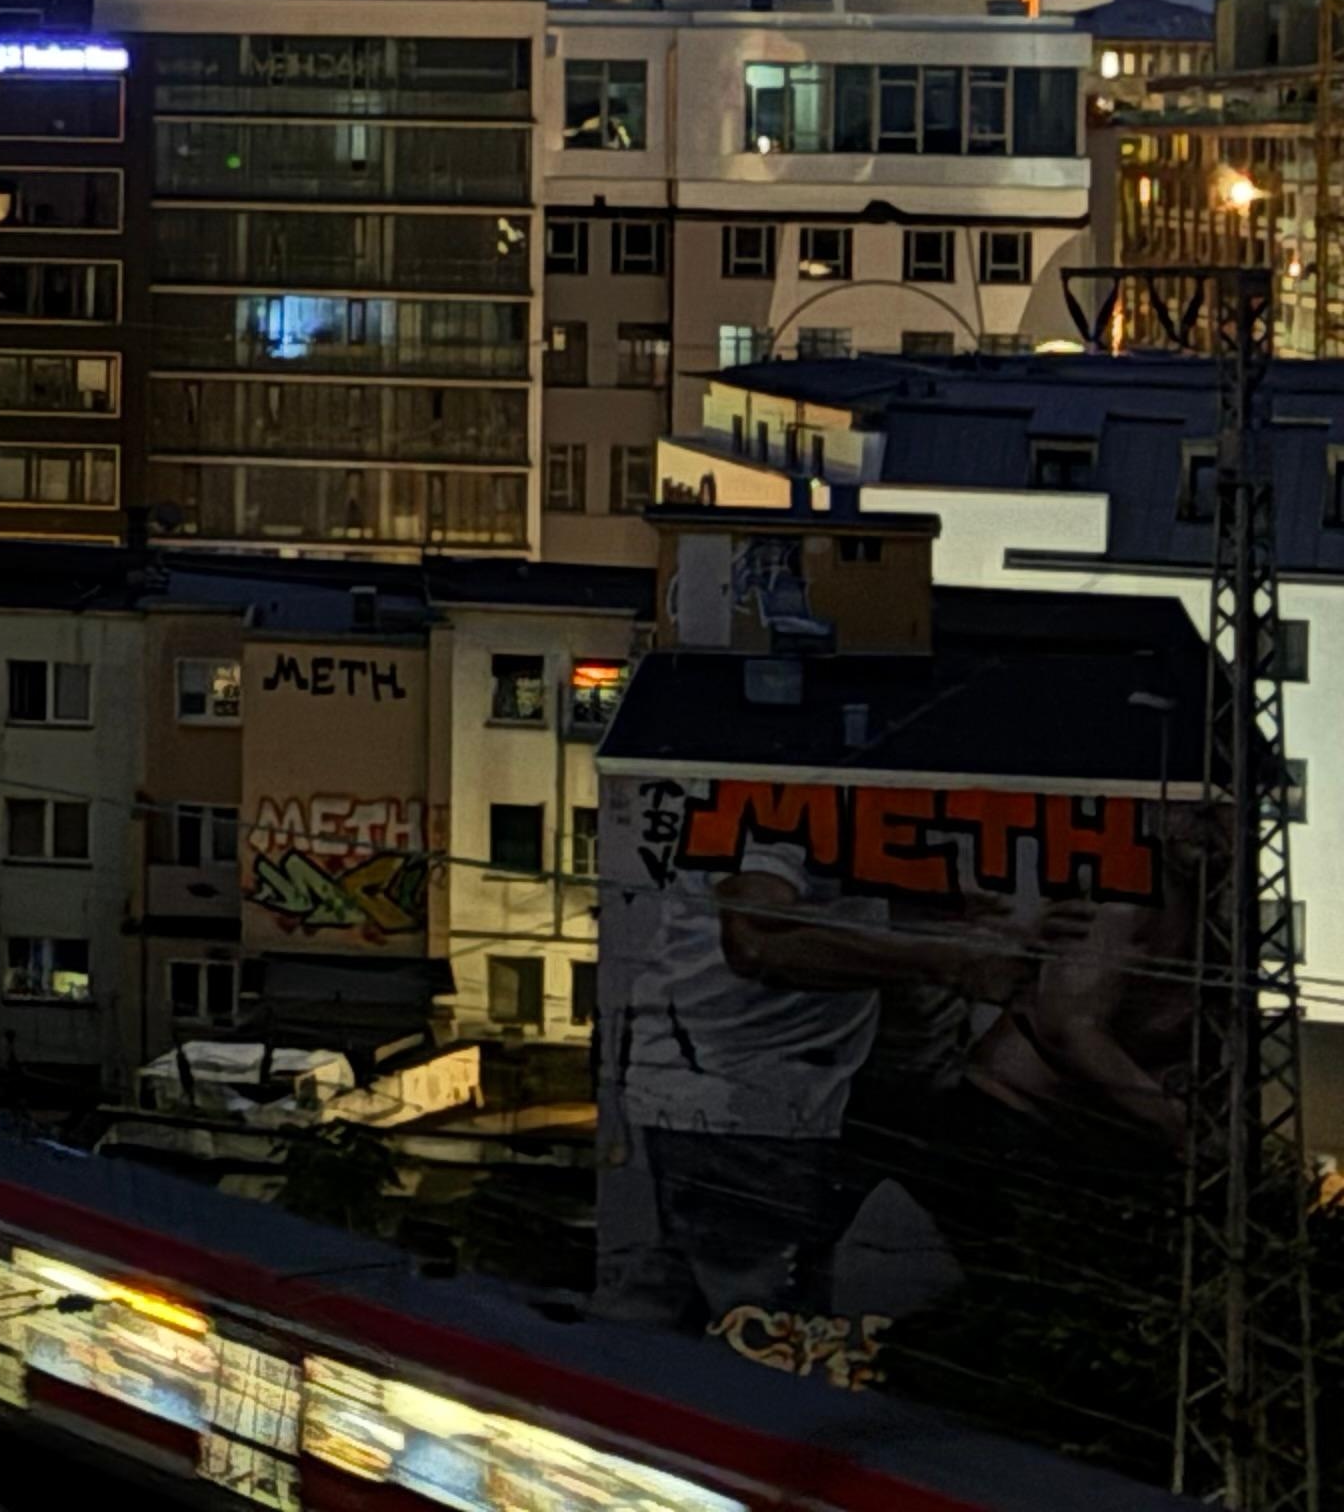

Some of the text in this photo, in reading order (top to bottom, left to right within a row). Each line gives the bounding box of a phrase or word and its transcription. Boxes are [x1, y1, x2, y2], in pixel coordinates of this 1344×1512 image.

[263, 654, 406, 701] METH
[248, 793, 428, 855] METH
[676, 779, 1164, 908] METH
